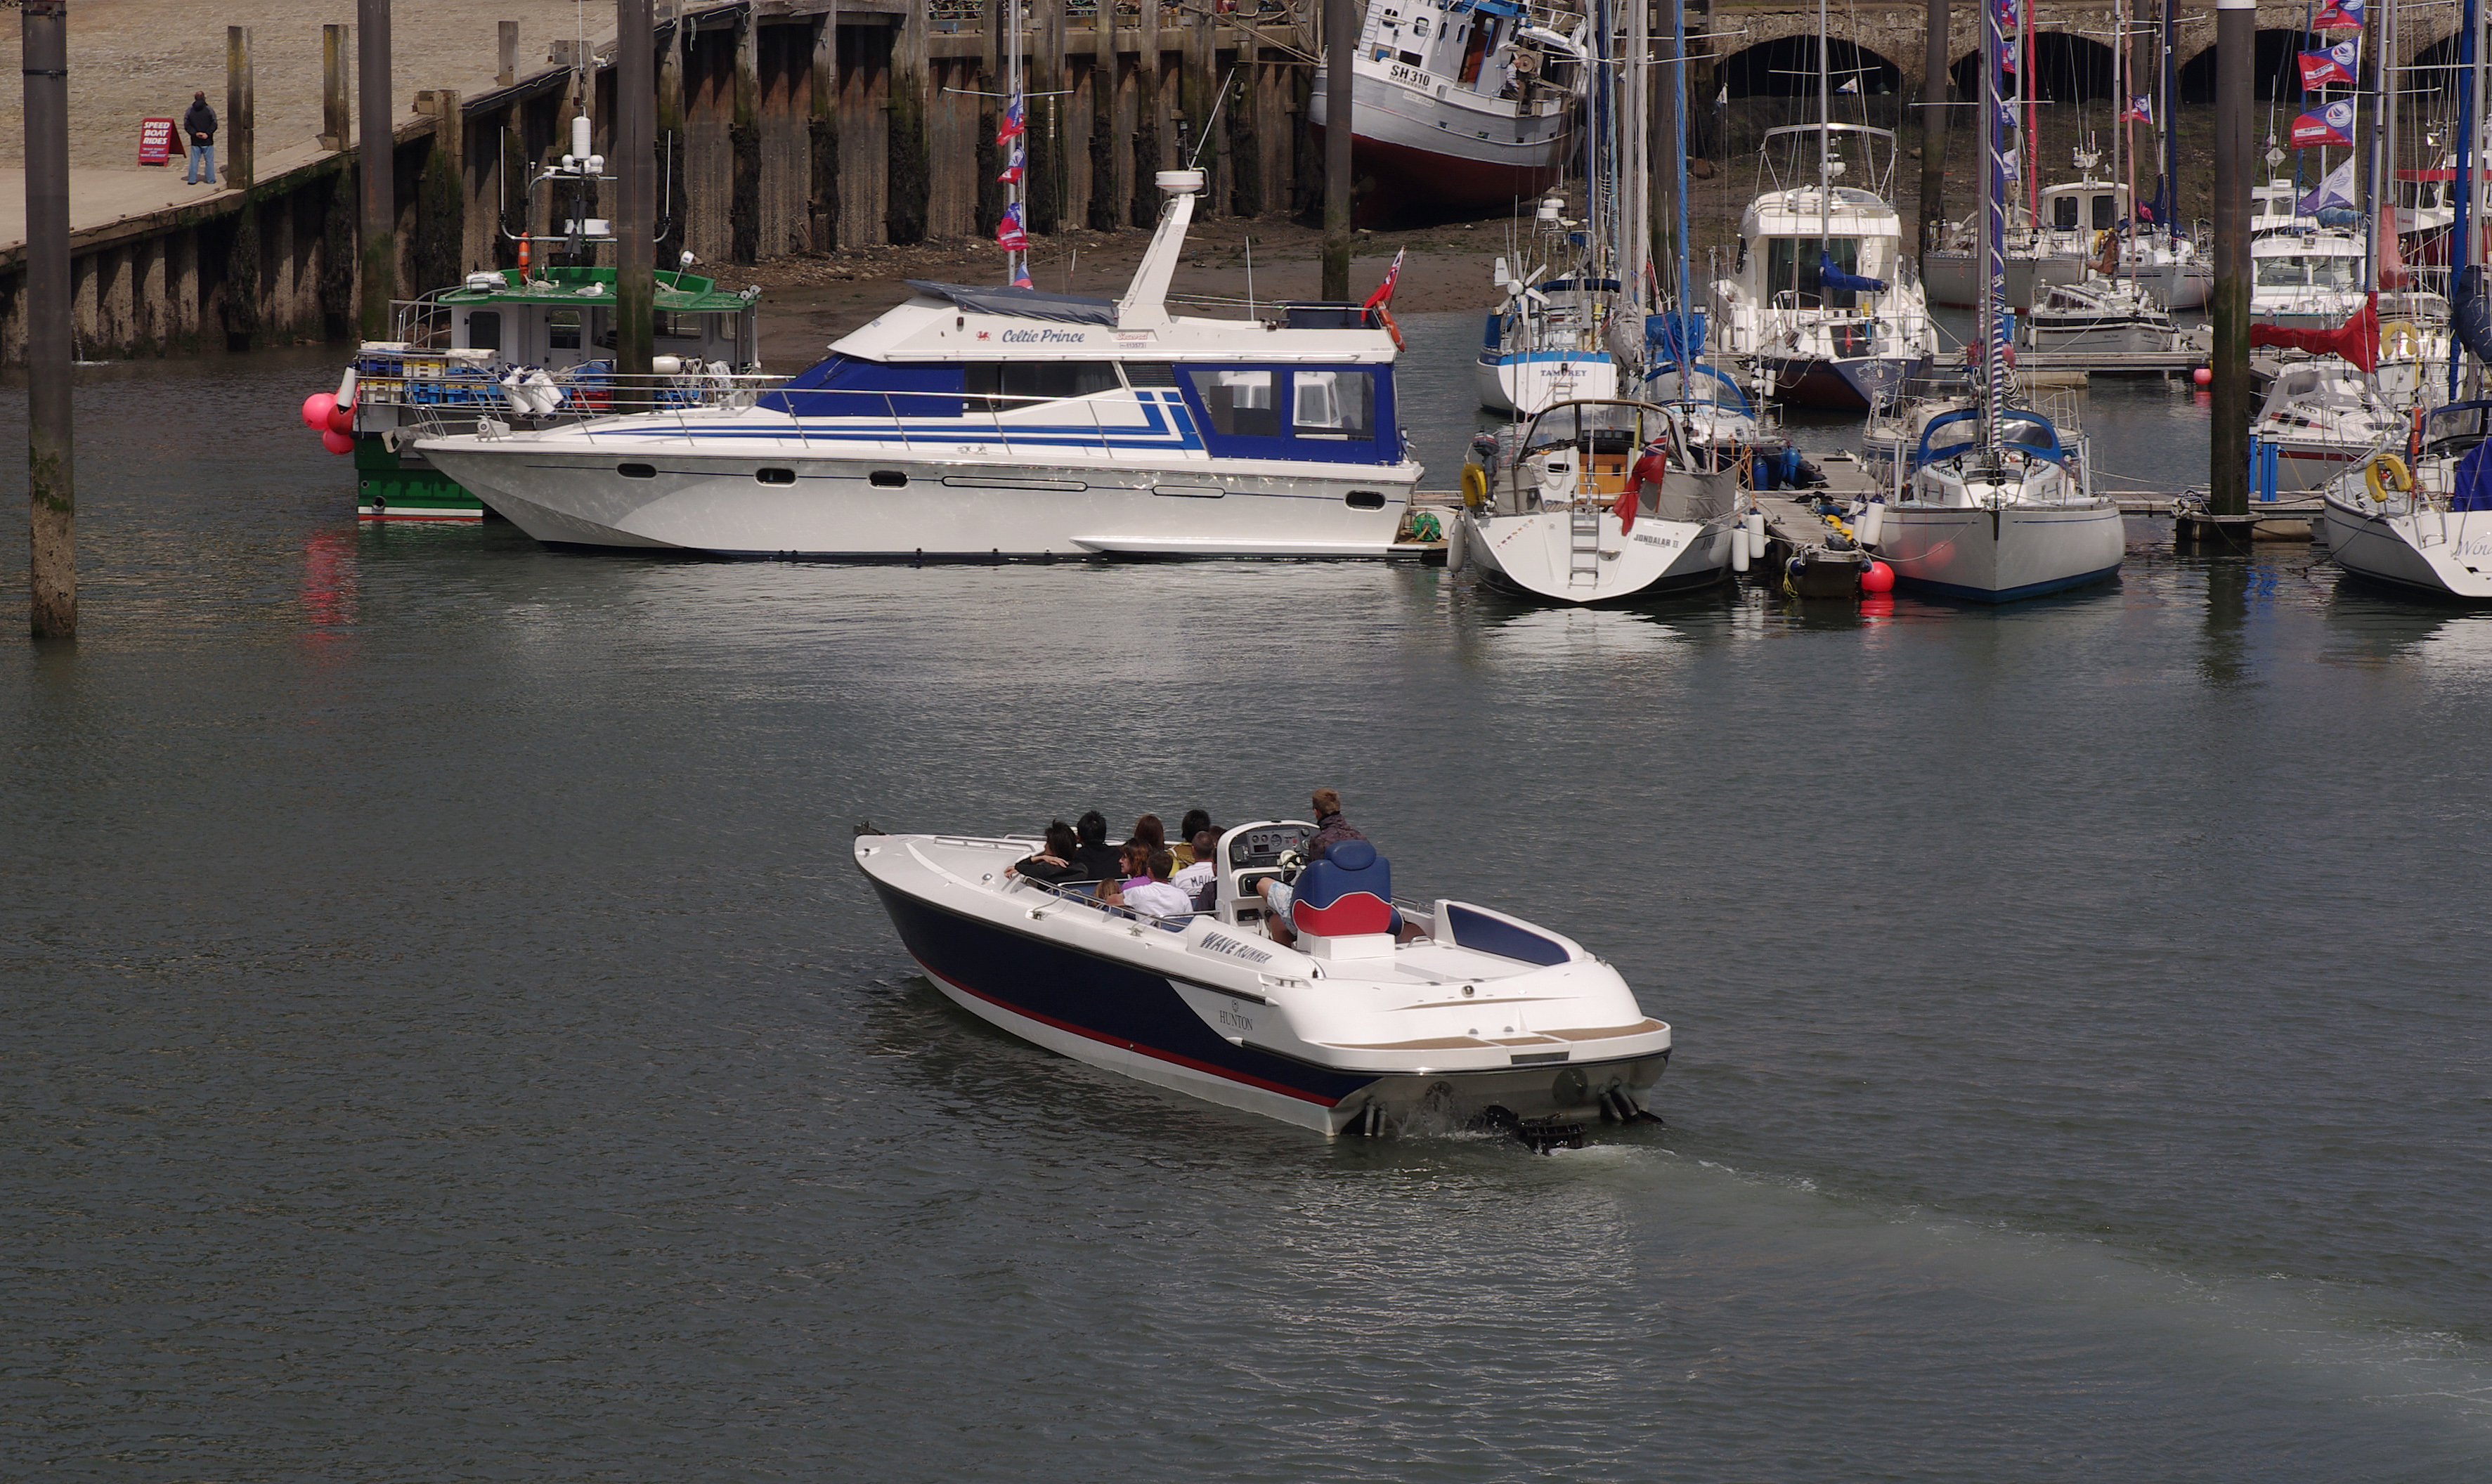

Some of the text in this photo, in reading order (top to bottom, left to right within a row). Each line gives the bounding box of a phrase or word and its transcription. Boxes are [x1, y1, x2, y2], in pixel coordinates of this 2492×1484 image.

[1391, 65, 1430, 86] SH 310
[1002, 329, 1085, 343] Celtic Prince
[1633, 534, 1671, 547] JONDALAR
[1199, 931, 1273, 964] WAVE RUNNER
[1219, 1010, 1253, 1031] HUNTON
